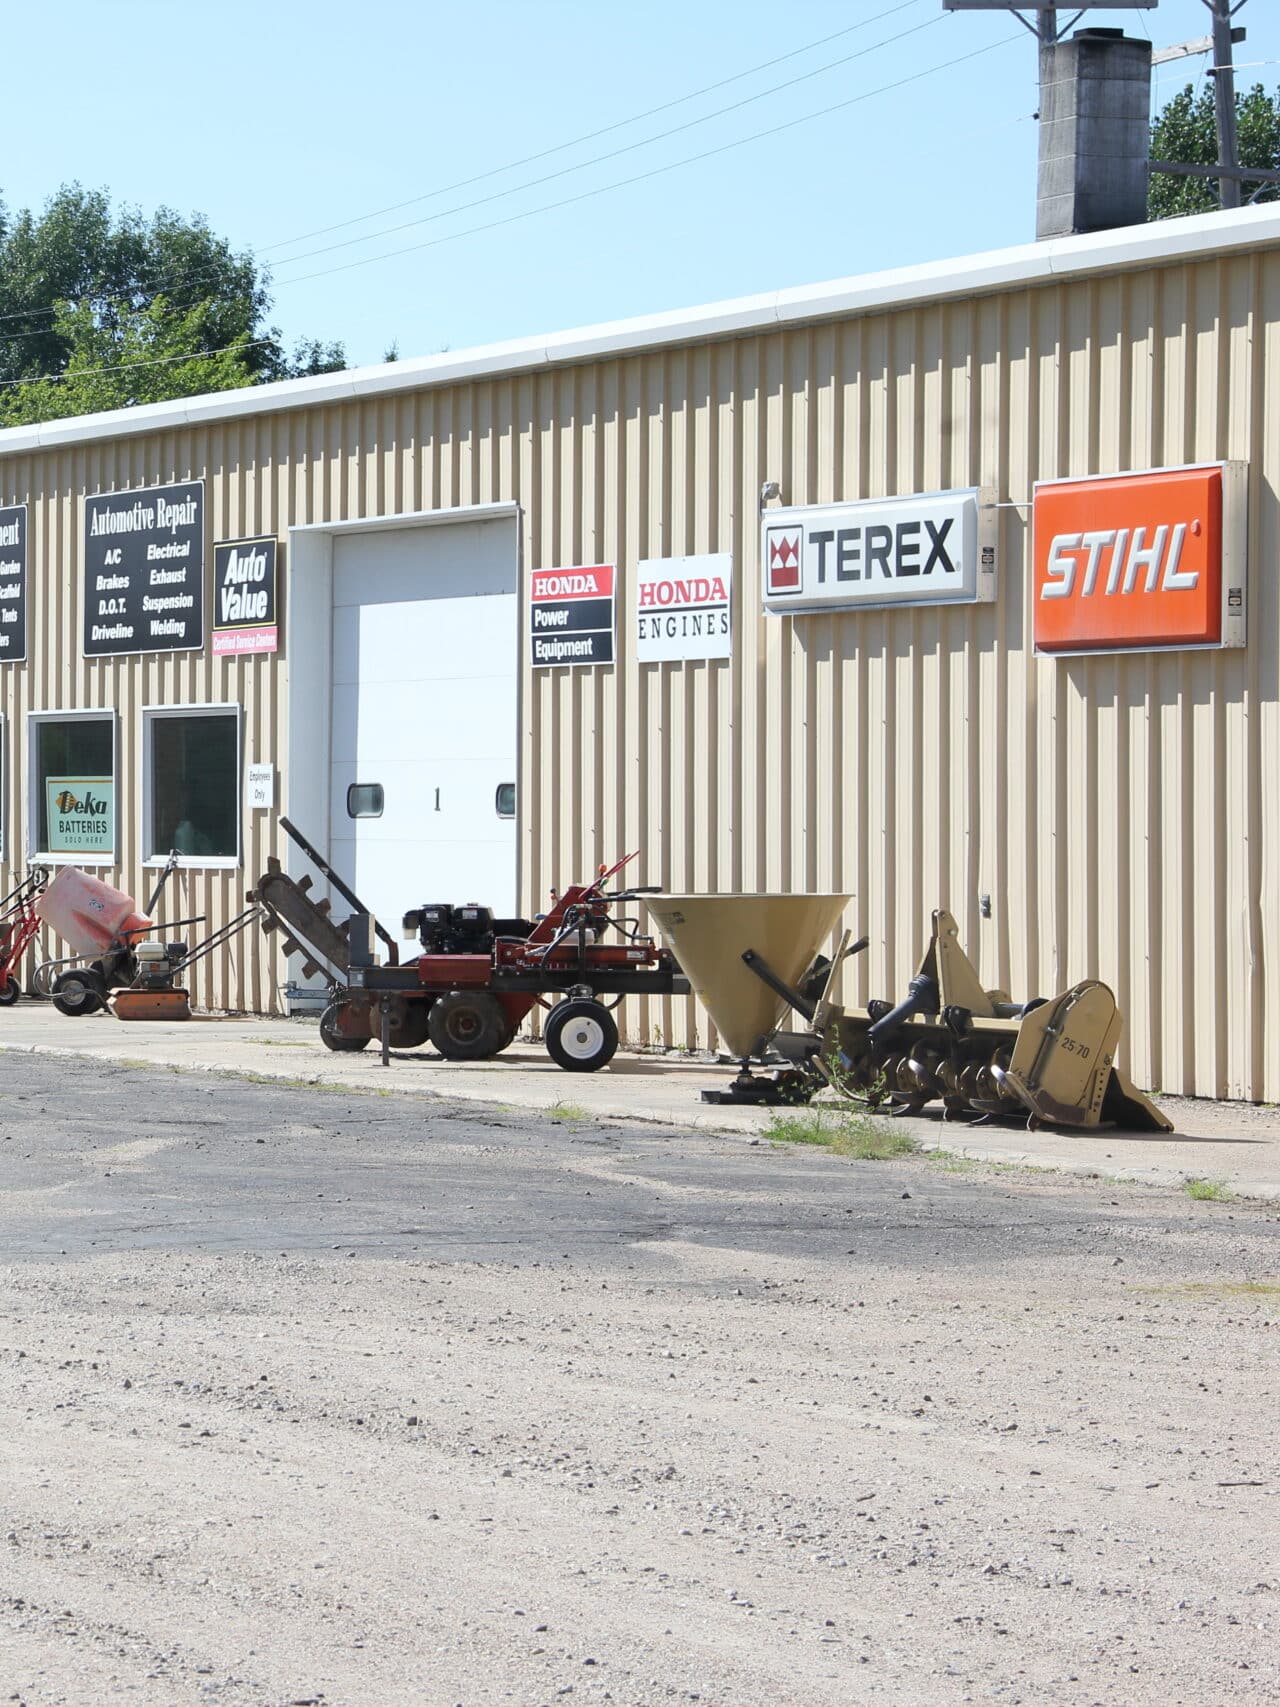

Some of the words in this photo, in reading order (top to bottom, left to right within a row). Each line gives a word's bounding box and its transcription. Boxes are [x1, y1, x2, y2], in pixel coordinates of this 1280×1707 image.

[90, 501, 154, 536] Automotive
[157, 494, 197, 534] Repair
[104, 548, 122, 565] A/C
[147, 540, 190, 560] Electrical
[809, 518, 955, 583] TEREX
[0, 560, 21, 575] Garden
[224, 547, 266, 585] Auto
[1040, 523, 1200, 601] STIHL
[96, 574, 130, 590] Brakes
[150, 567, 187, 585] Exhaust
[534, 574, 598, 596] HONDA
[639, 577, 728, 606] HONDA
[99, 597, 127, 615] D.O.T.
[142, 592, 193, 613] Suspension
[221, 584, 268, 622] Value
[2, 608, 17, 623] Tents
[535, 609, 569, 627] Power
[638, 612, 728, 639] ENGINES
[91, 623, 134, 640] Driveline
[150, 619, 186, 638] Welding
[535, 638, 593, 660] Equipment
[58, 791, 107, 816] Deka
[255, 789, 265, 802] Only
[59, 821, 107, 833] BATTERIES
